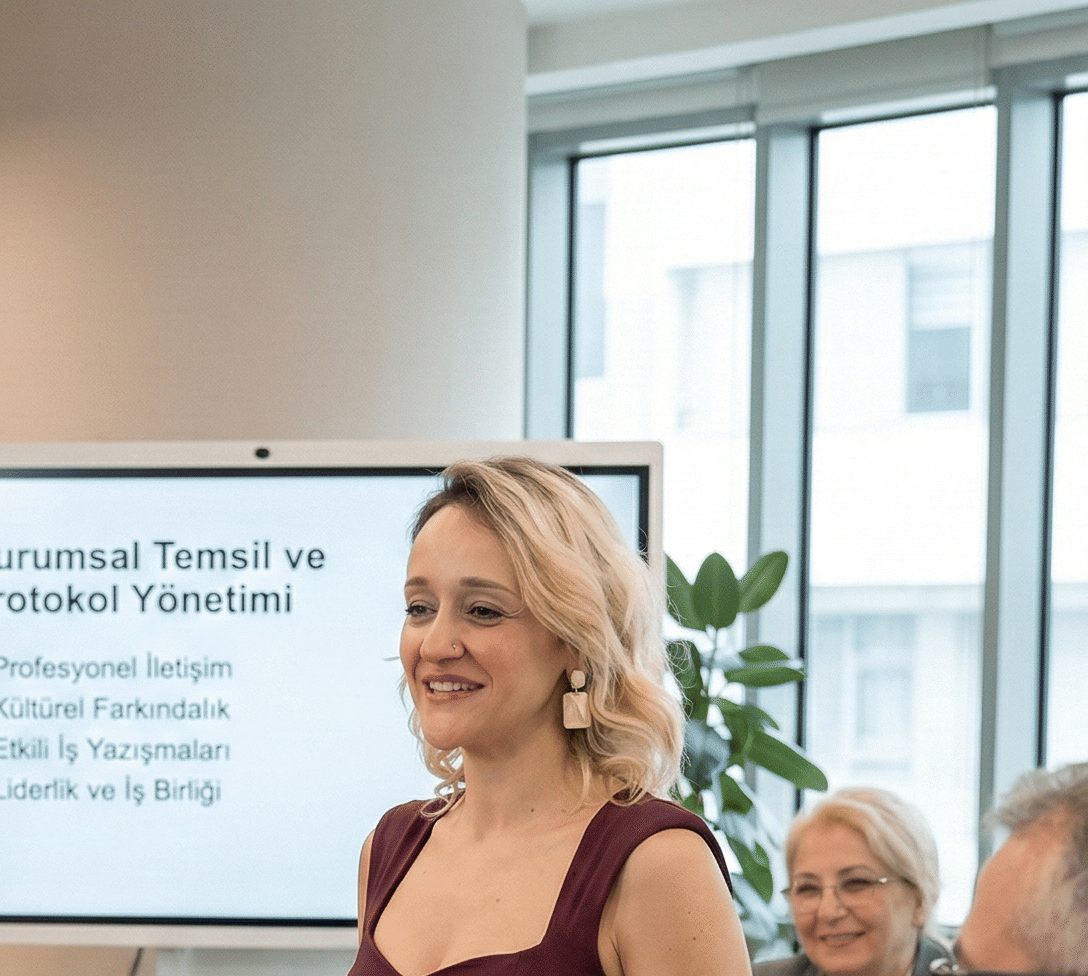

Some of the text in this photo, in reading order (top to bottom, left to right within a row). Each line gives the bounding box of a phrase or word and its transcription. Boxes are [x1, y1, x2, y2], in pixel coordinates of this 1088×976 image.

[153, 540, 270, 571] Temsil
[284, 548, 326, 571] ve
[131, 583, 292, 615] Yönetimi
[146, 652, 233, 685] İletişim
[92, 696, 231, 721] Farkındalık
[58, 733, 79, 766] İş
[86, 737, 231, 767] Yazışmaları
[86, 784, 117, 802] ve
[124, 775, 146, 807] İş
[153, 777, 222, 808] Birliği
